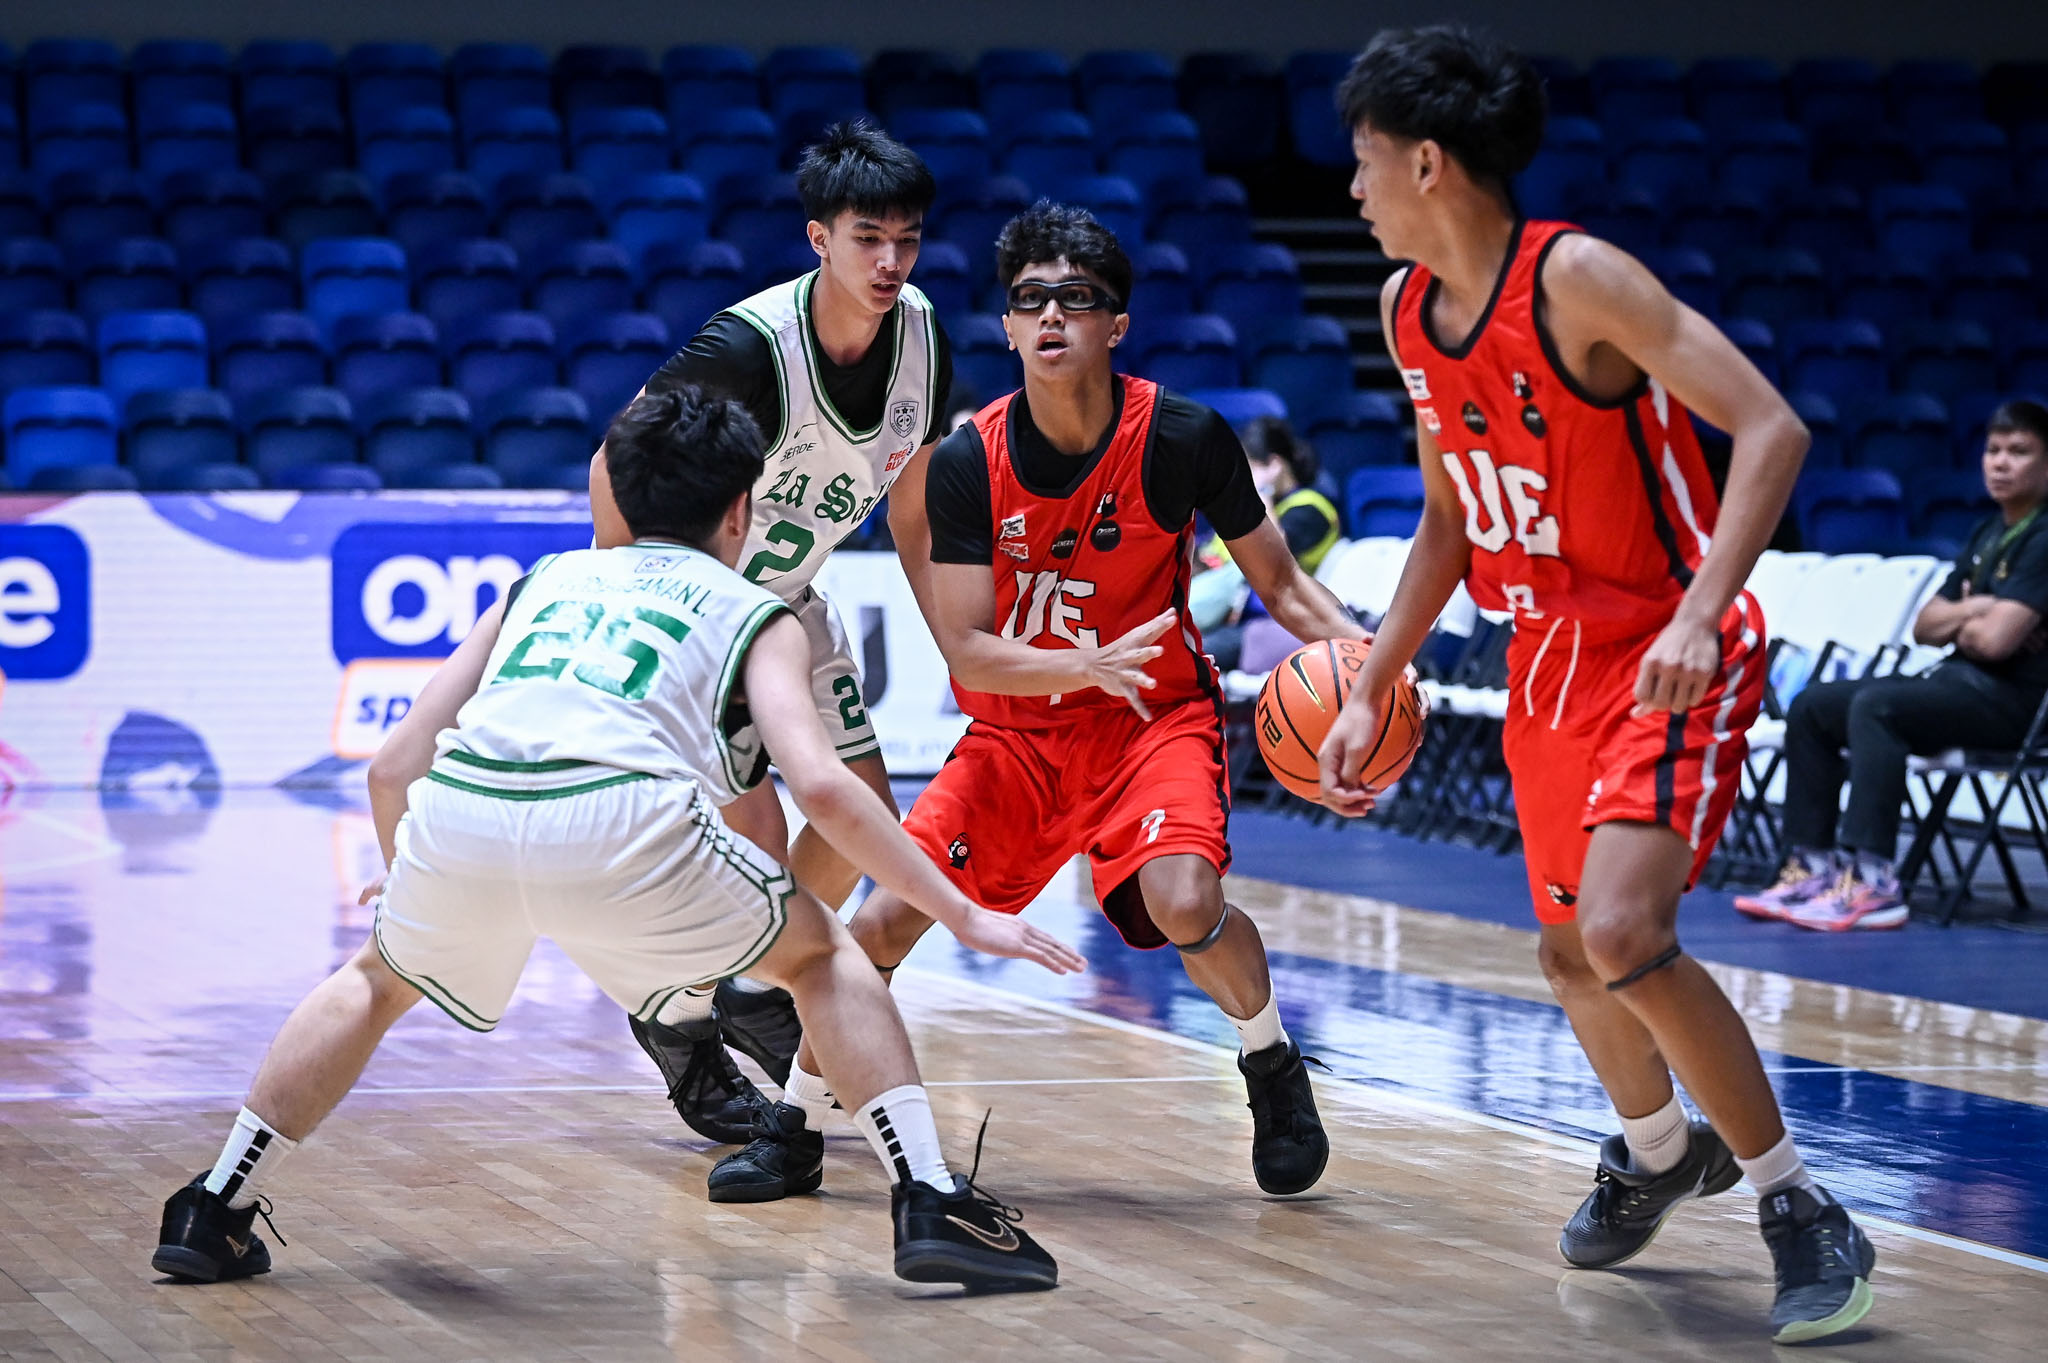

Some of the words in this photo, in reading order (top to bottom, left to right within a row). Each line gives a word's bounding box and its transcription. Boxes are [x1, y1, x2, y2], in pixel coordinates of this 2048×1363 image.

[758, 466, 812, 509] La
[1442, 449, 1561, 557] UE
[742, 519, 816, 585] 2
[361, 554, 525, 646] on
[1001, 570, 1100, 649] UE
[490, 600, 692, 701] 25
[832, 674, 867, 731] 2
[1141, 808, 1166, 844] 7
